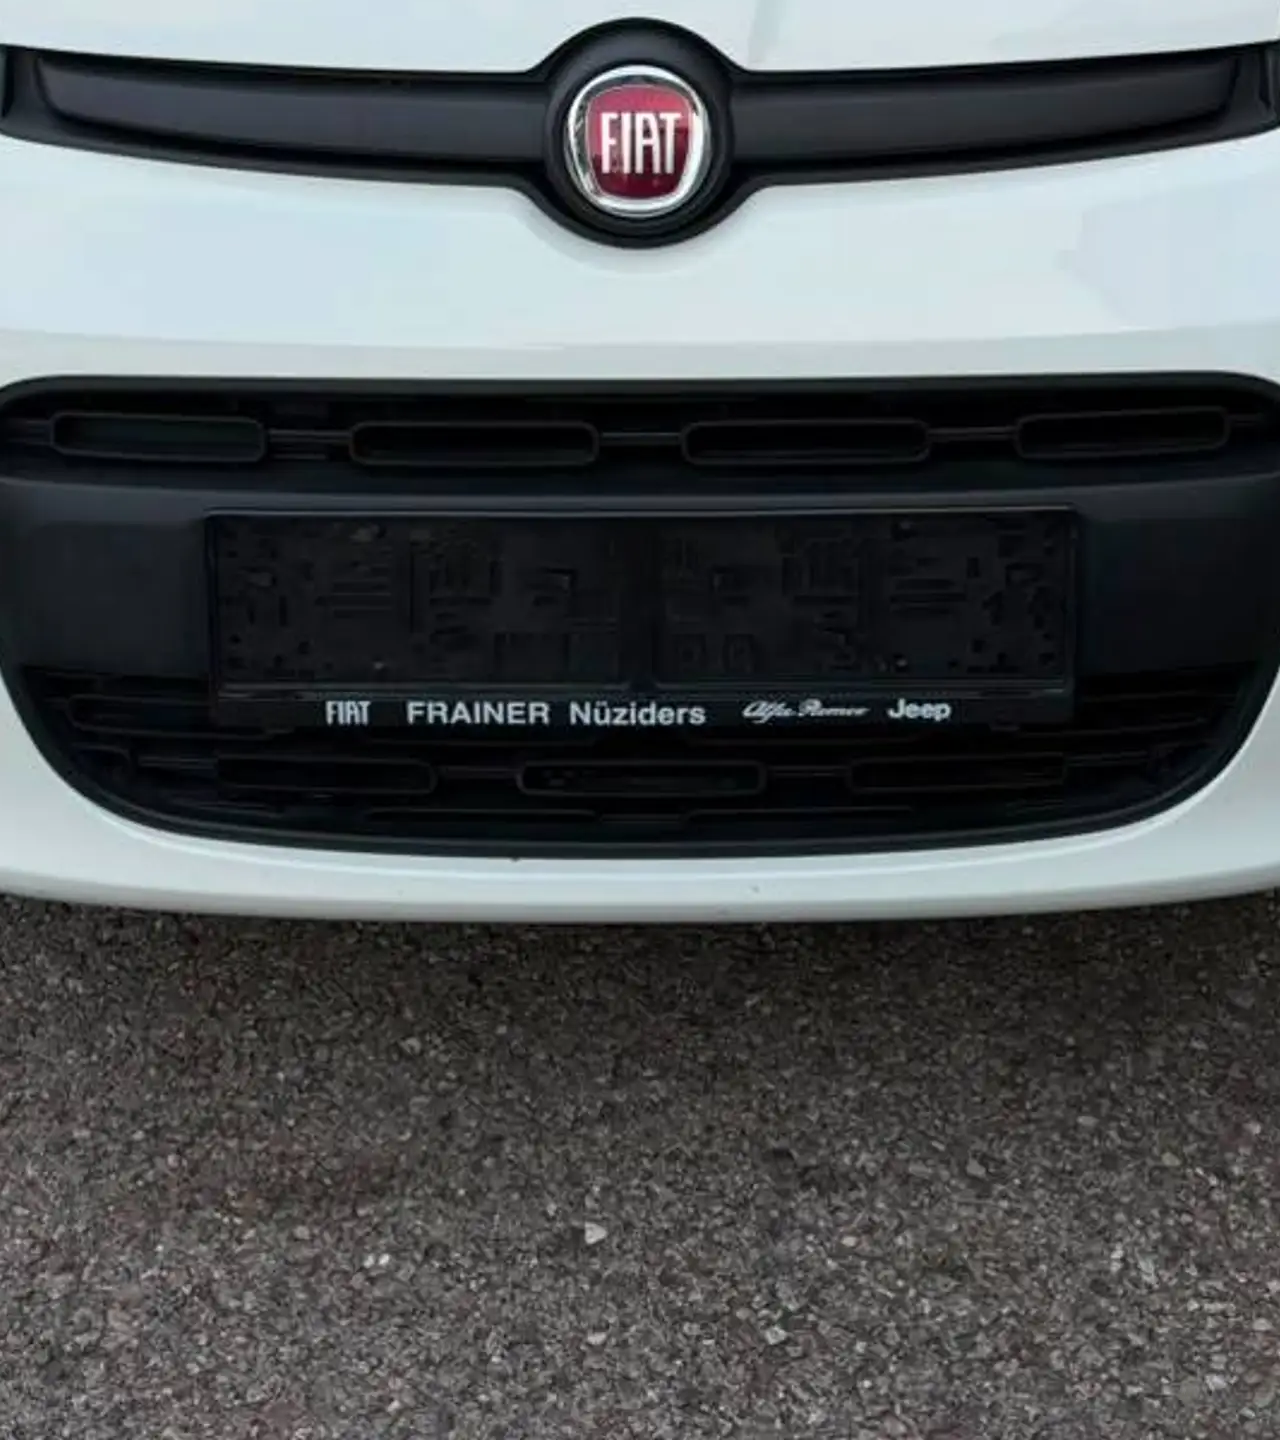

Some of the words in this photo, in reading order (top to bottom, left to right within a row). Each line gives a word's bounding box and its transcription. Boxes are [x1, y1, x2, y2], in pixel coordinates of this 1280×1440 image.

[601, 111, 682, 174] FIAT
[325, 700, 371, 725] FIAT
[406, 700, 551, 725] FRAINER
[569, 700, 707, 726] Nüziders
[887, 698, 952, 721] Jeep
